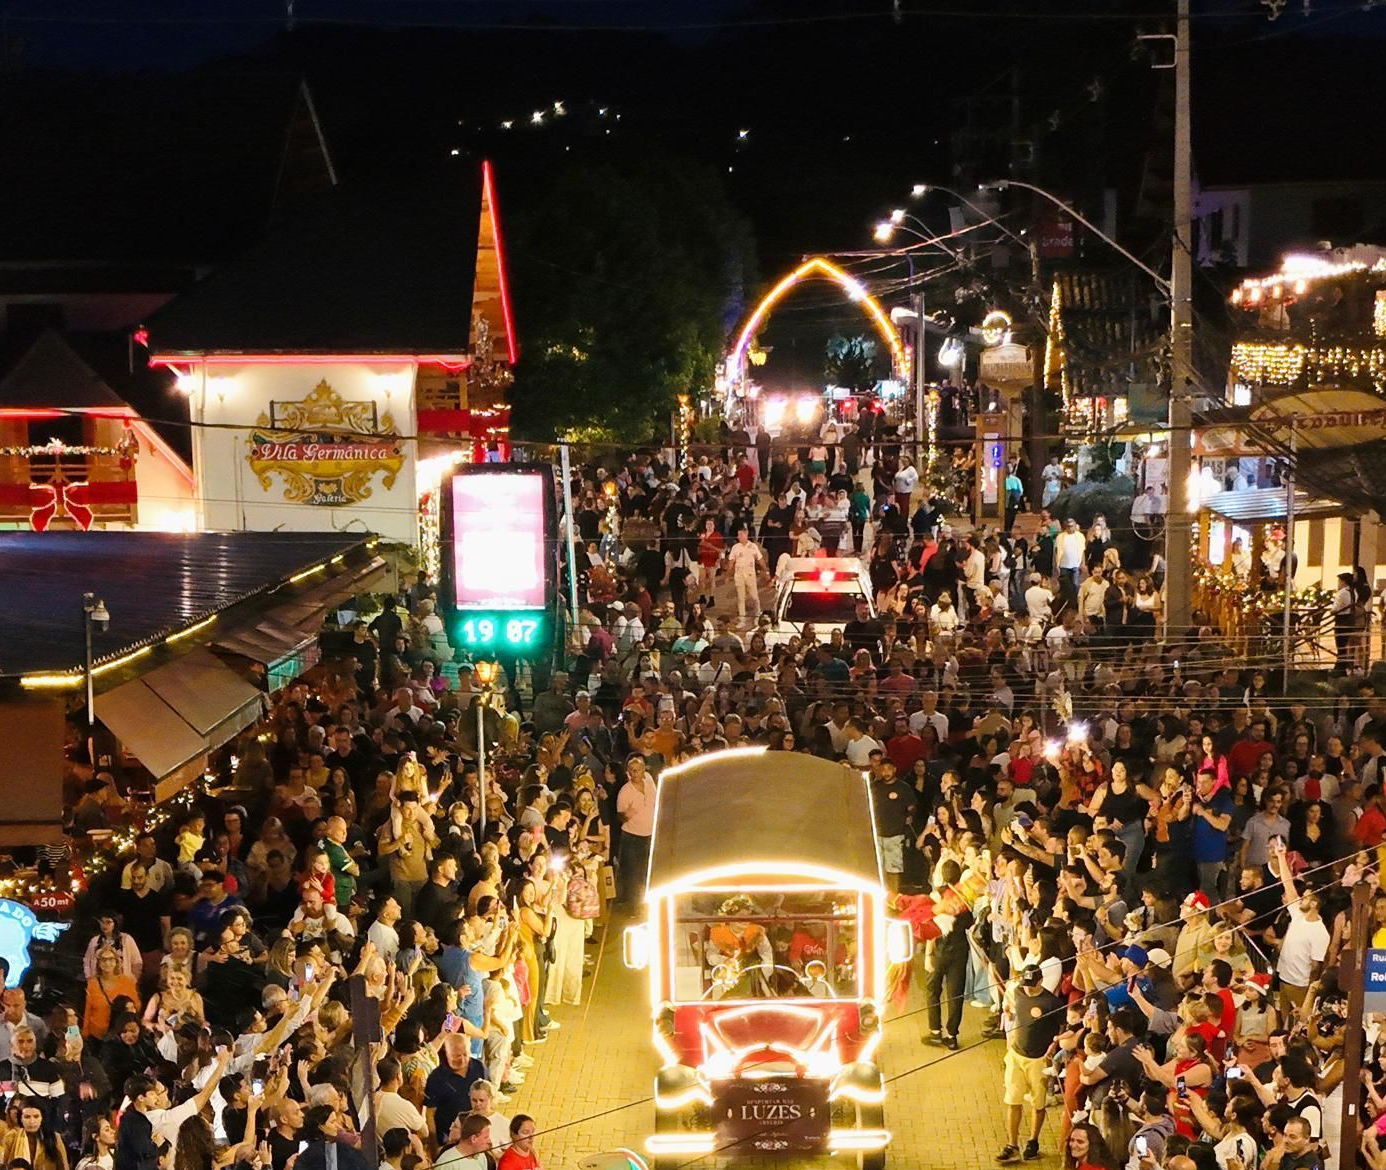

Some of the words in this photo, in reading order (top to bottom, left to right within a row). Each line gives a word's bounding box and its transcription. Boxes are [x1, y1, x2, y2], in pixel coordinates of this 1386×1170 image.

[260, 443, 298, 461] Vila
[302, 443, 388, 463] Germânica
[313, 493, 347, 505] Galeria
[464, 619, 494, 643] 19
[506, 619, 537, 643] 07
[741, 1104, 802, 1120] LUZES
